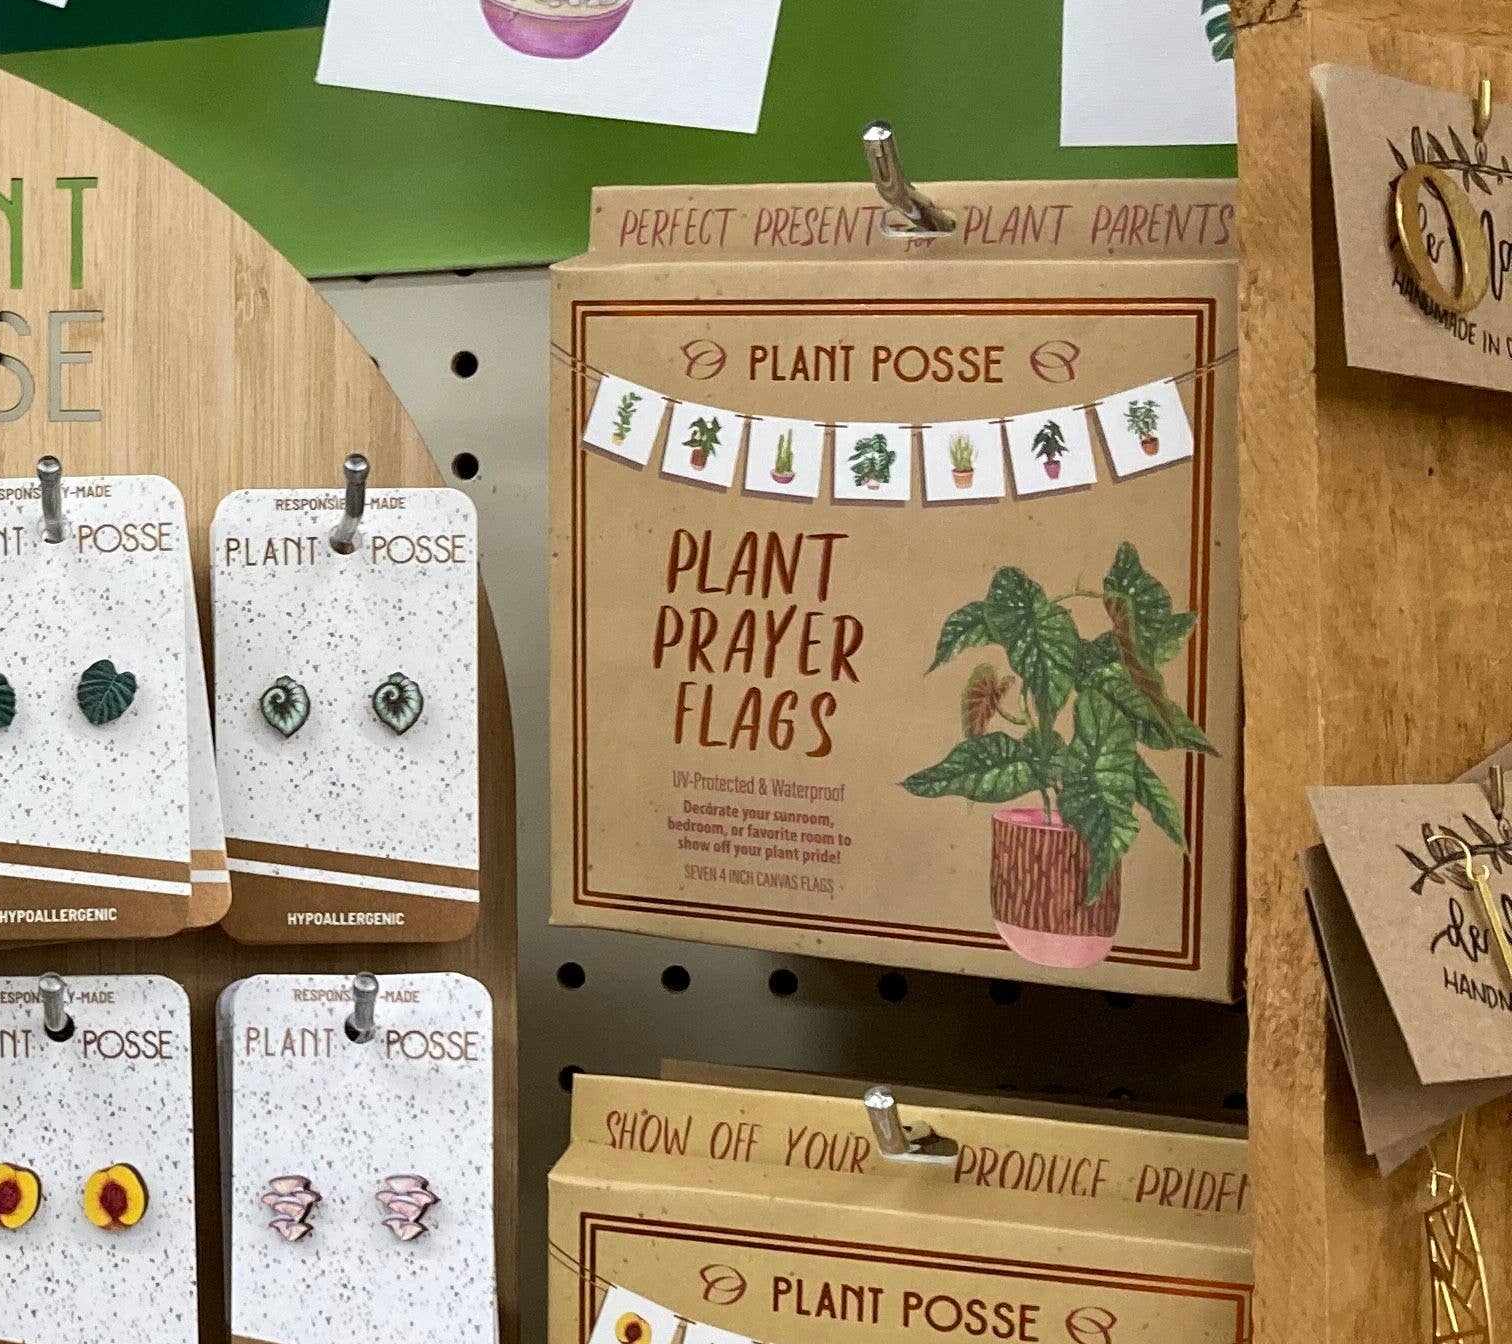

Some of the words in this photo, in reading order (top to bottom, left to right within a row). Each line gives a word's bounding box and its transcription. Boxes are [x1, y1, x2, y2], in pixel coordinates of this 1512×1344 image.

[619, 207, 741, 249] PERFECT
[963, 204, 1074, 246] PLANT
[1090, 202, 1236, 247] PARENTS
[749, 344, 856, 382] PLANT
[873, 345, 1006, 383] POSSE
[78, 522, 174, 554] POSSE
[226, 536, 319, 568] PLANT
[372, 534, 467, 565] POSSE
[666, 528, 850, 602] PLANT
[651, 604, 864, 684] PRAYER
[672, 680, 837, 758] FLAGS
[672, 769, 755, 796] UV-Protected
[757, 777, 769, 797] &
[771, 778, 846, 804] Waterproof
[666, 815, 729, 838] bedroom,
[731, 824, 745, 838] or
[746, 823, 798, 843] favorite
[800, 828, 835, 846] room
[837, 832, 853, 847] to
[682, 799, 739, 819] Decorate
[741, 806, 771, 822] your
[773, 809, 836, 829] sunroom,
[677, 836, 711, 852] show
[713, 838, 731, 855] off
[732, 843, 763, 859] your
[764, 845, 800, 862] plant
[802, 849, 842, 867] pride!
[684, 863, 717, 883] SEVEN
[718, 868, 728, 883] 4
[728, 869, 755, 885] INCH
[755, 871, 800, 891] CANVAS
[800, 874, 836, 894] FLAGS
[83, 1030, 174, 1060] POSSE
[246, 1027, 335, 1058] PLANT
[387, 1029, 479, 1061] POSSE
[605, 1110, 693, 1157] SHOW
[709, 1121, 760, 1164] OFF
[785, 1125, 872, 1174] YOUR
[954, 1143, 1111, 1199] PRODUCE
[772, 1275, 885, 1326] PLANT
[901, 1292, 1042, 1343] POSSE
